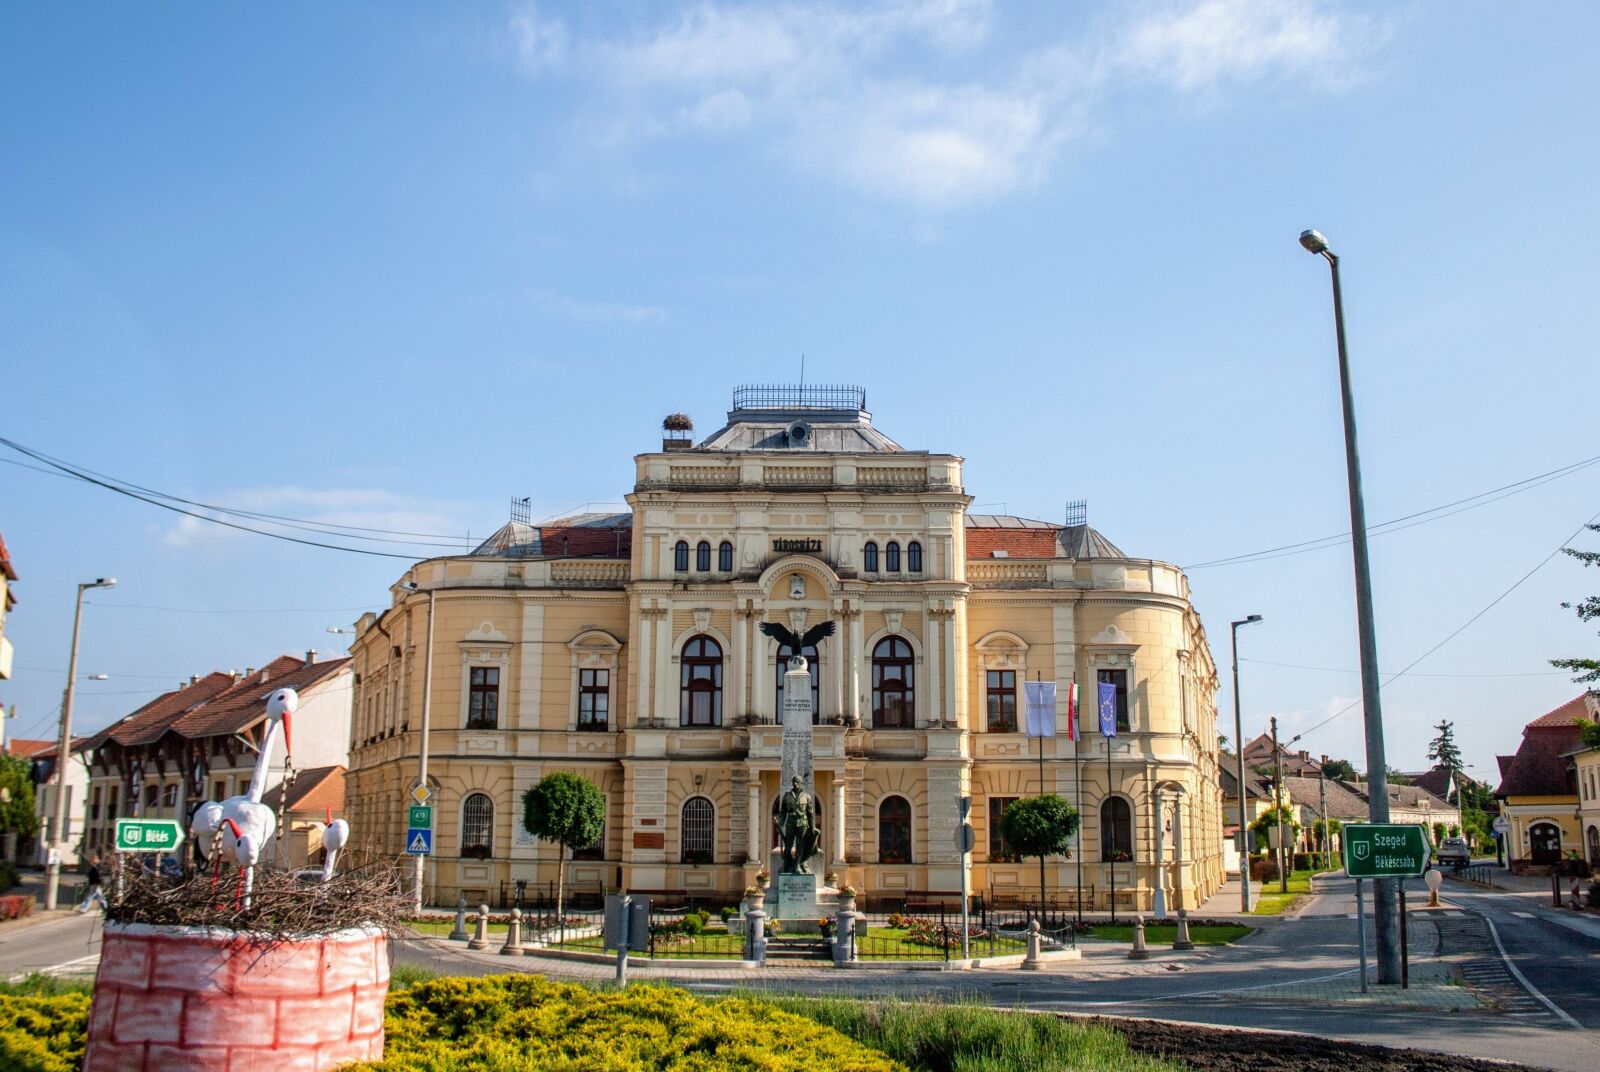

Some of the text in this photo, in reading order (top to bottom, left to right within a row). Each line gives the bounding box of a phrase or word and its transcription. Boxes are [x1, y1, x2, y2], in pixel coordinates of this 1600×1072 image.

[772, 537, 823, 552] VÁROSHÁZA
[1374, 833, 1406, 849] Szeged
[1357, 845, 1366, 856] 47
[1375, 855, 1415, 868] Békéscsaba
